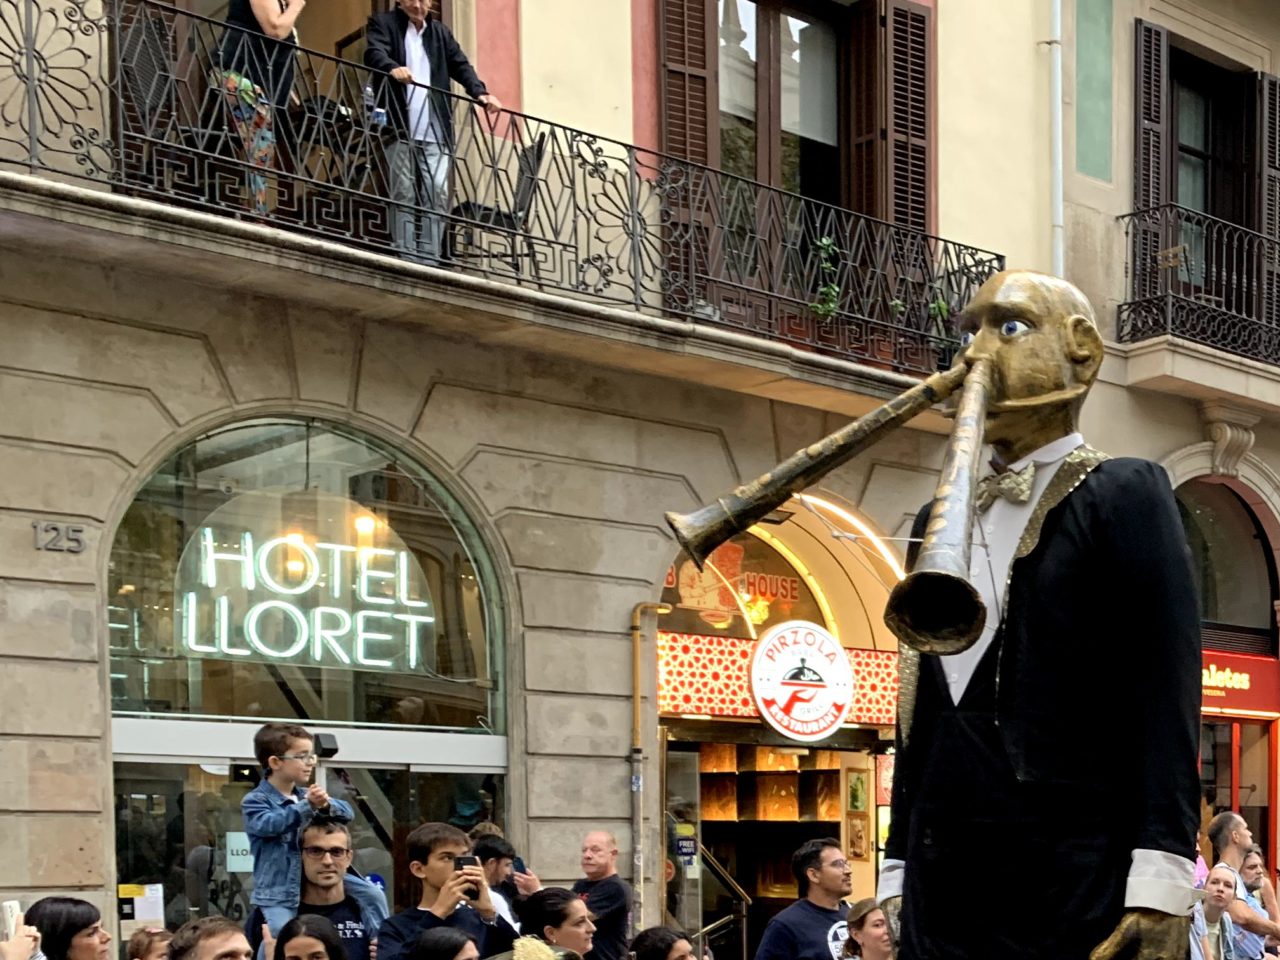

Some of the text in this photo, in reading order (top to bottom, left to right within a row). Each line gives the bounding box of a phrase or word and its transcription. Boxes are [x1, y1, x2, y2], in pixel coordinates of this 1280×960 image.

[31, 520, 87, 555] 125
[199, 526, 429, 608] HOTEL
[745, 572, 799, 601] HOUSE
[181, 590, 436, 670] LLORET
[765, 630, 838, 665] PIRZOLA
[1201, 663, 1250, 690] aletes
[768, 703, 841, 734] RESTAURANT
[230, 848, 251, 857] LLO
[678, 840, 695, 848] FREE
